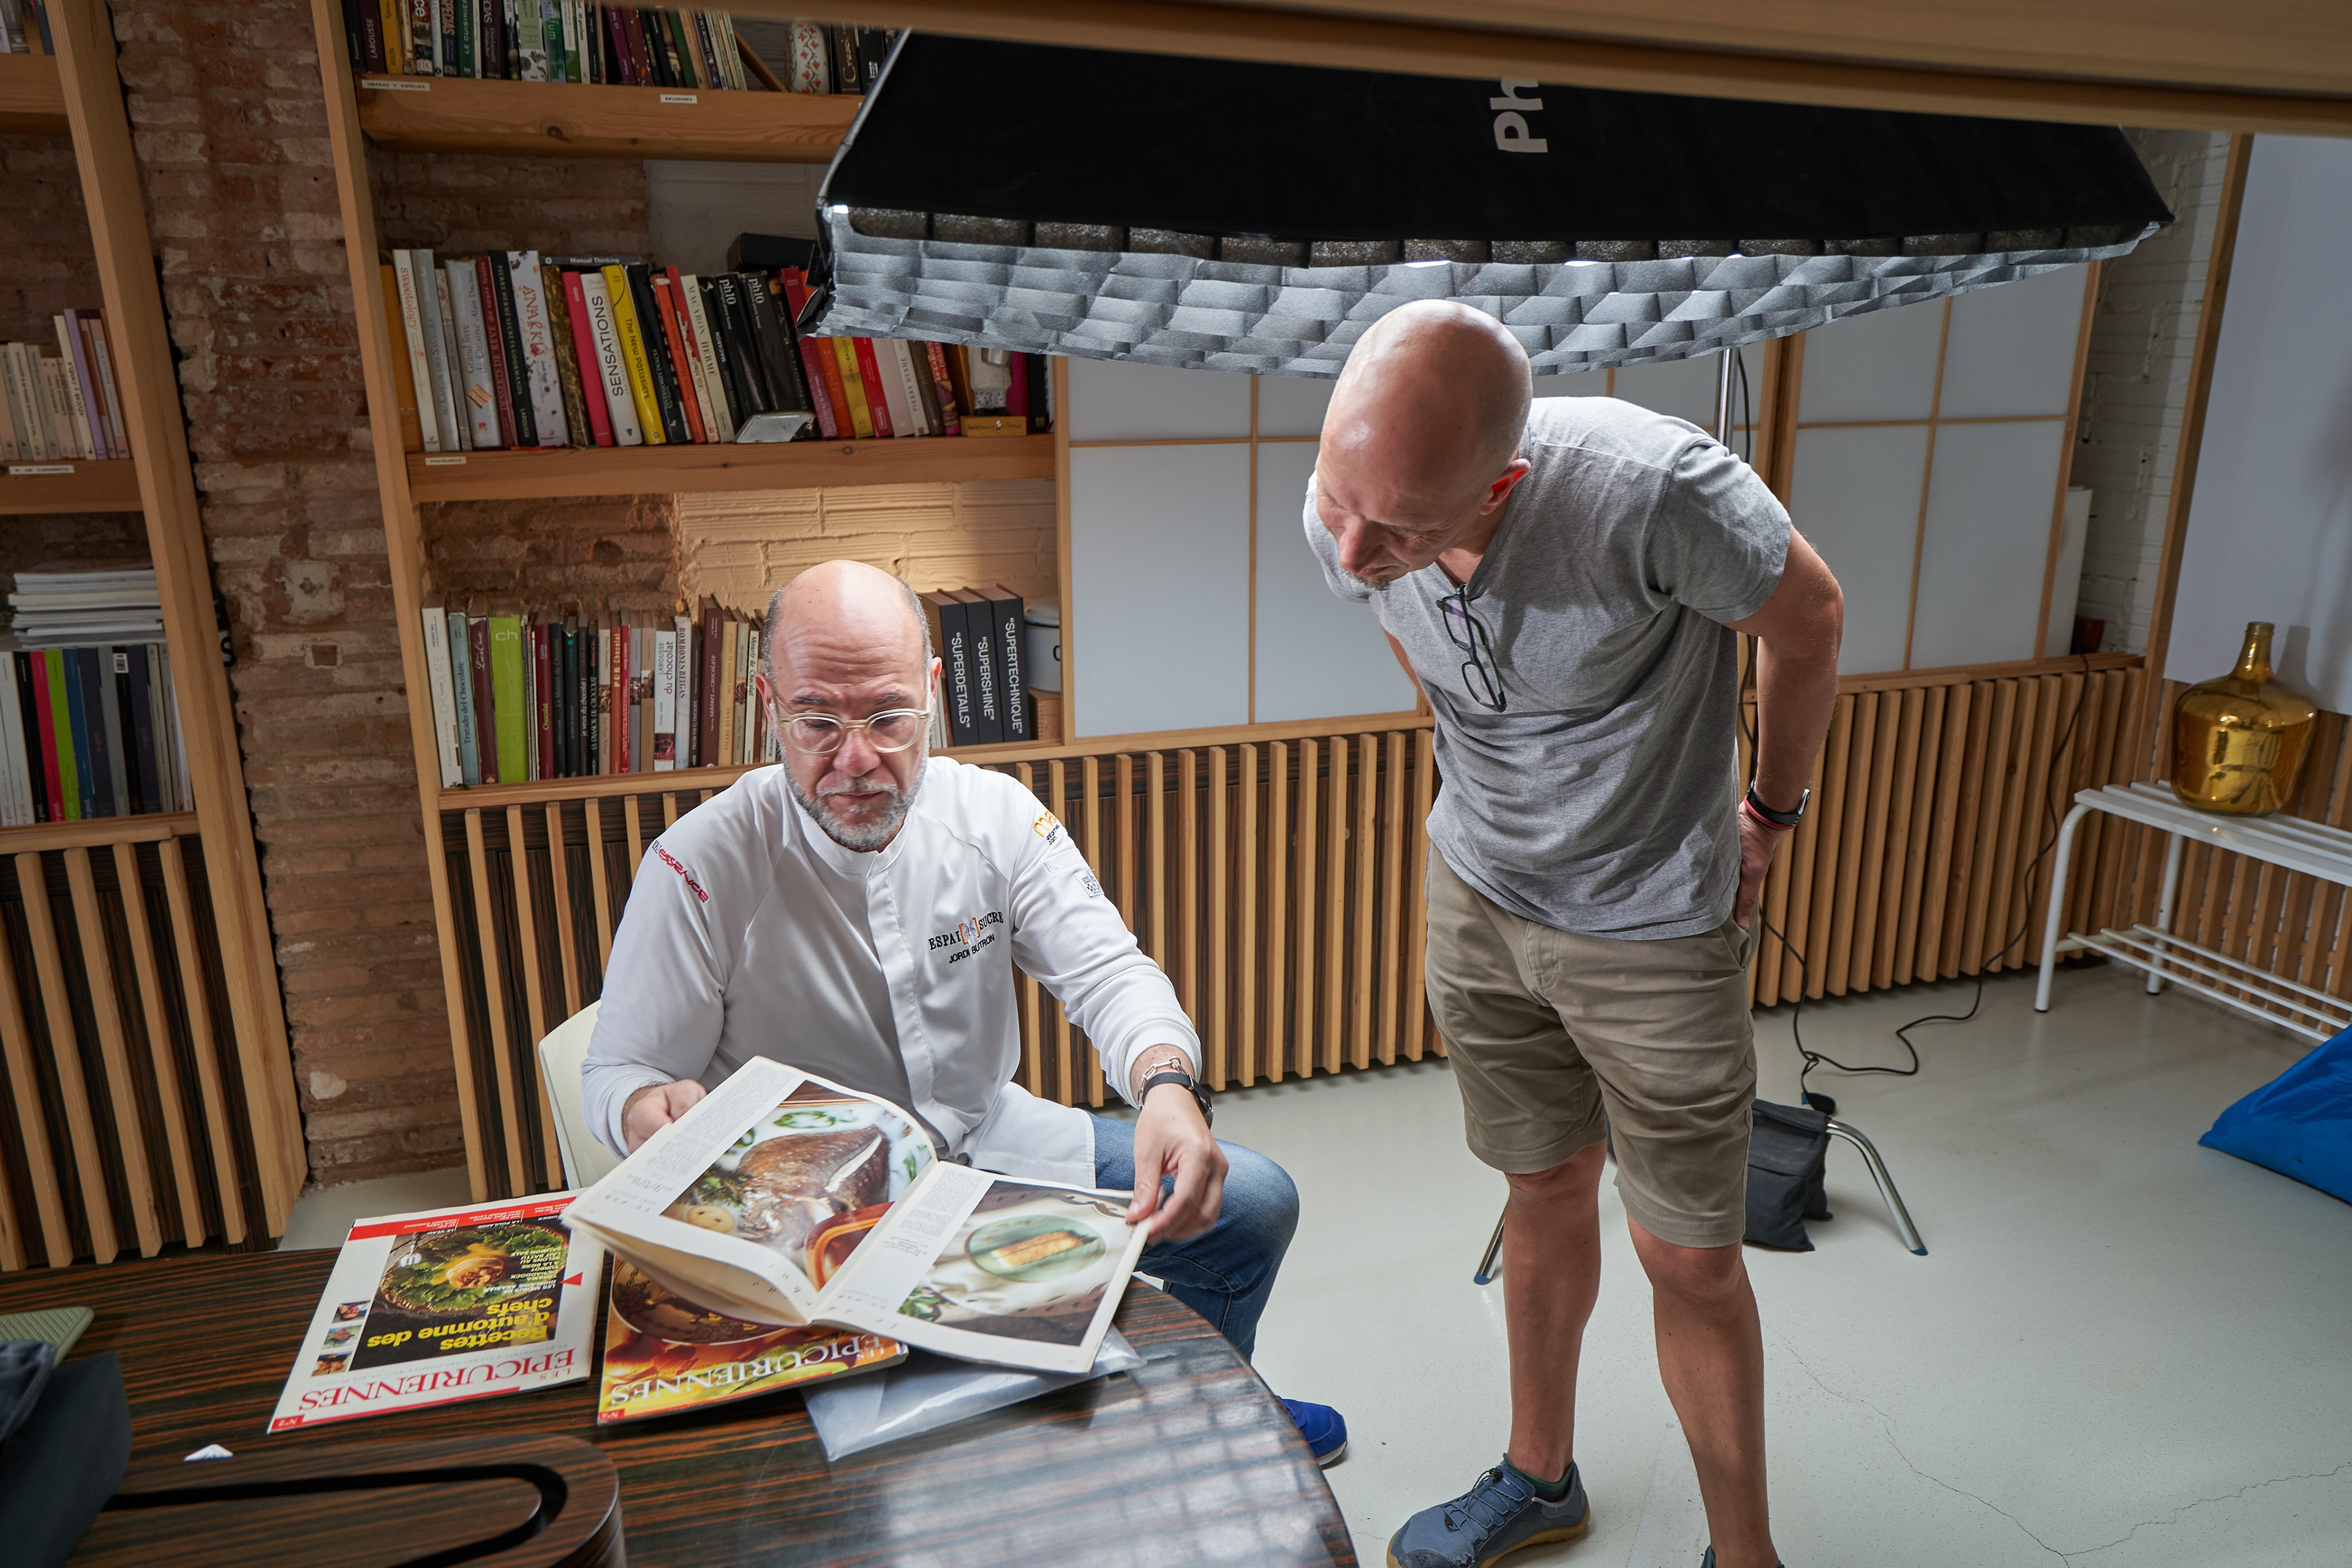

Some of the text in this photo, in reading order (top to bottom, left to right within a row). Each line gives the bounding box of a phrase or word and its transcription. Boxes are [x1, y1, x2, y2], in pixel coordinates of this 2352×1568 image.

[366, 18, 377, 58] LAROUSSE
[400, 267, 418, 330] sweetology
[719, 278, 737, 305] ph10
[748, 277, 765, 304] ph10
[688, 285, 705, 335] MACARON
[462, 324, 475, 374] Grand livre
[473, 324, 484, 358] Cuisine
[592, 296, 624, 397] SENSATIONS
[625, 317, 635, 334] The
[630, 335, 639, 355] New
[715, 331, 727, 363] MACARON
[927, 341, 938, 371] LAROUS
[67, 361, 78, 385] CANELA
[907, 386, 918, 412] PIERRE
[496, 630, 518, 641] ch
[663, 641, 673, 680] chocolat
[663, 680, 673, 694] du
[458, 662, 471, 744] Tratado del Chocolate
[929, 911, 1004, 950] ESPAI SUCRE
[949, 933, 995, 963] JORDI BUTRON
[530, 1246, 562, 1254] SAUMON
[483, 1284, 517, 1292] ARABIAN
[487, 1298, 553, 1316] chefs
[367, 1312, 550, 1348] d'automne des
[440, 1324, 548, 1351] Recettes
[611, 1334, 883, 1404] EPICURIENNES
[857, 1347, 884, 1360] LES
[299, 1348, 575, 1411] EPICURIENNES
[539, 1368, 571, 1382] LES
